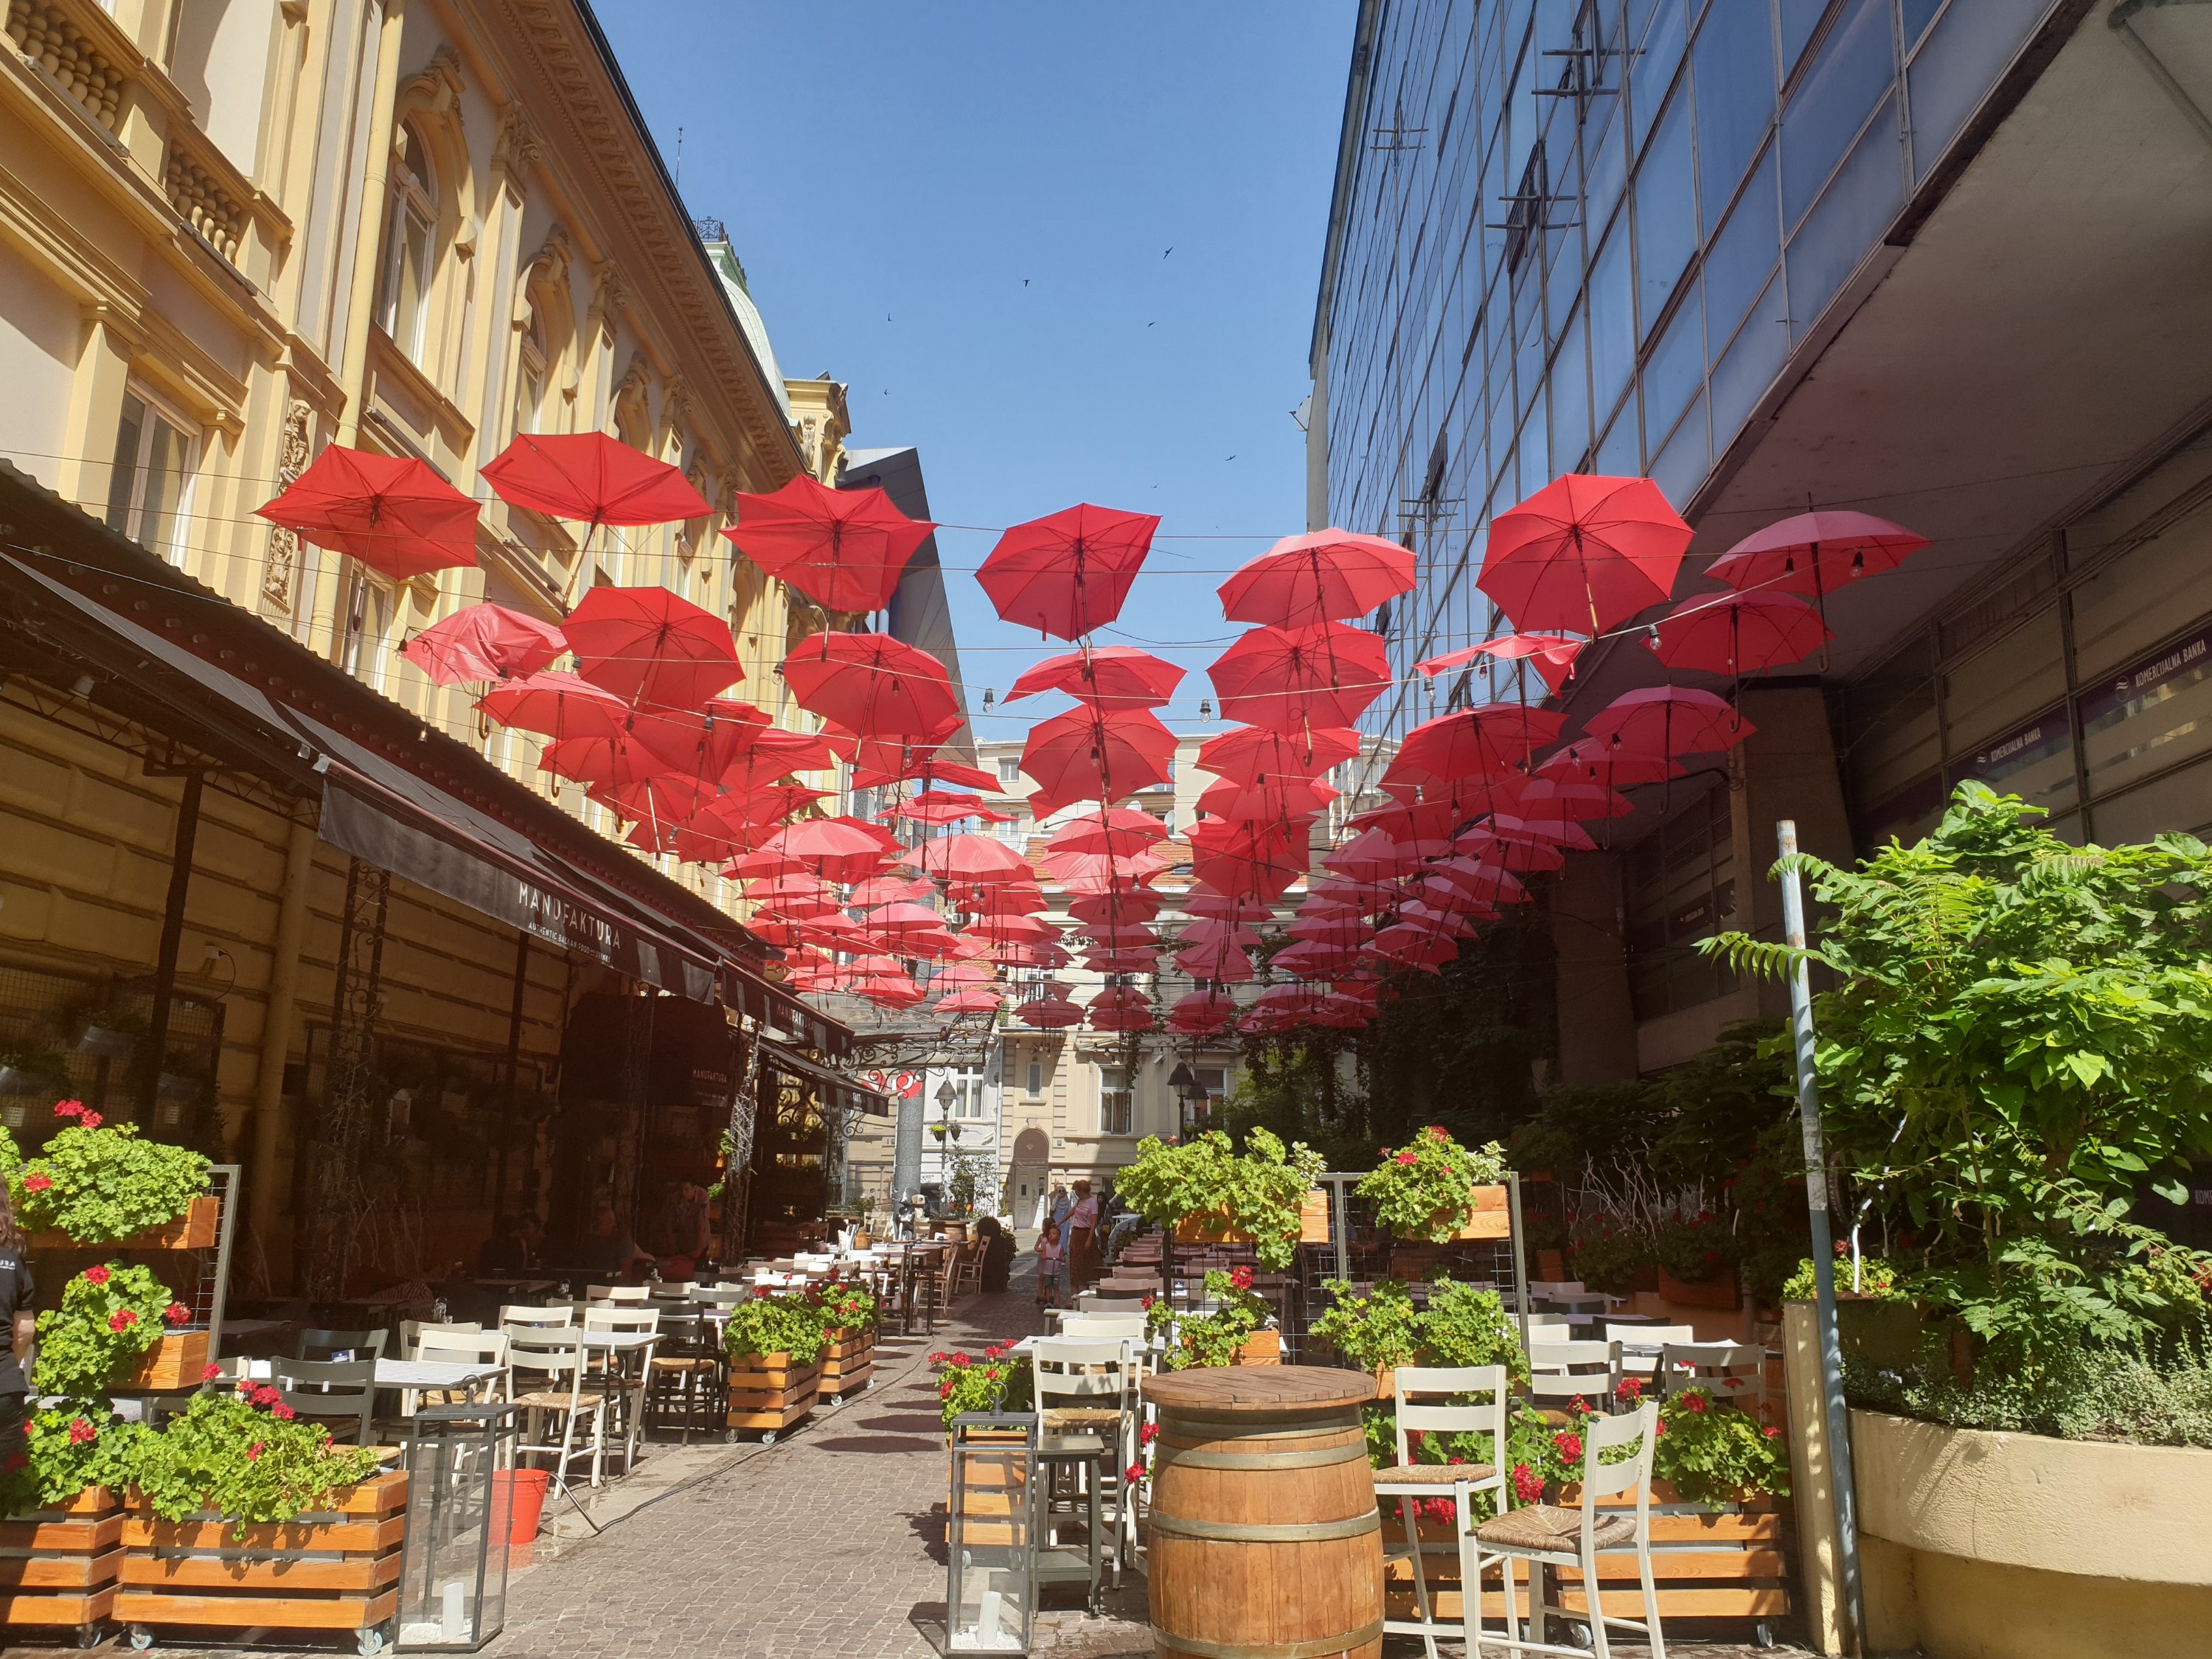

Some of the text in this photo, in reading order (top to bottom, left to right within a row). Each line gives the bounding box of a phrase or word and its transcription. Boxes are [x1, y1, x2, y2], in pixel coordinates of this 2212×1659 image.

[2135, 639, 2206, 688] KOMERCIJALNA BANKA
[1991, 727, 2042, 762] KOMERCIJALNA BANKA
[518, 881, 620, 949] MANUFAKTURA
[528, 922, 557, 939] AUTHENTIC
[558, 934, 577, 948] BALKAN
[578, 943, 590, 954] FOOD
[692, 1068, 727, 1083] MANUFAKTURA
